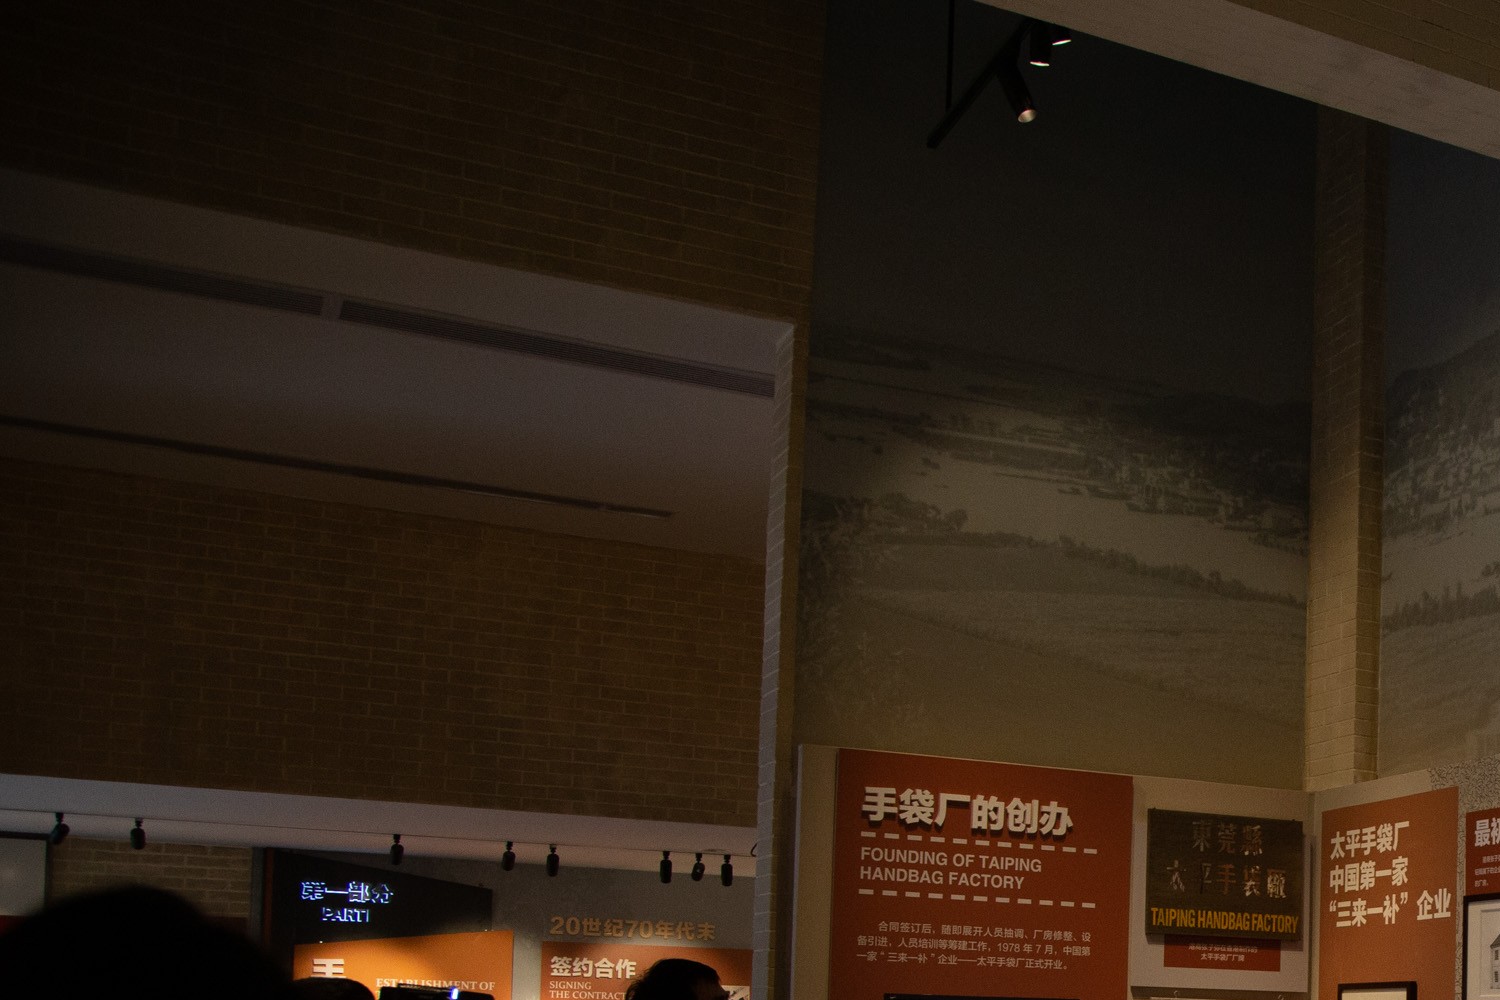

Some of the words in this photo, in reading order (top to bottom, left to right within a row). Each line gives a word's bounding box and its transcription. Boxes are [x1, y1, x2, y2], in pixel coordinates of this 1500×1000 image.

[861, 786, 1073, 836] 手袋厂的创办
[1330, 820, 1410, 860] 太平手袋厂
[861, 846, 948, 866] FOUNDING
[952, 853, 975, 869] OF
[979, 855, 1042, 873] TAIPING
[860, 866, 943, 885] HANDBAG
[949, 872, 1025, 890] FACTORY
[1329, 856, 1409, 894] 中国第一家
[300, 881, 395, 904] 第一部分
[550, 914, 717, 942] 20世纪70年代末
[1151, 907, 1199, 928] TAIPING
[1197, 910, 1250, 931] HANDBAG
[1251, 913, 1299, 934] FACTORY
[549, 955, 638, 979] 签约合作
[479, 981, 496, 991] OF
[548, 990, 570, 999] THE
[572, 991, 627, 1000] CONTRACT
[549, 980, 592, 990] SIGNING
